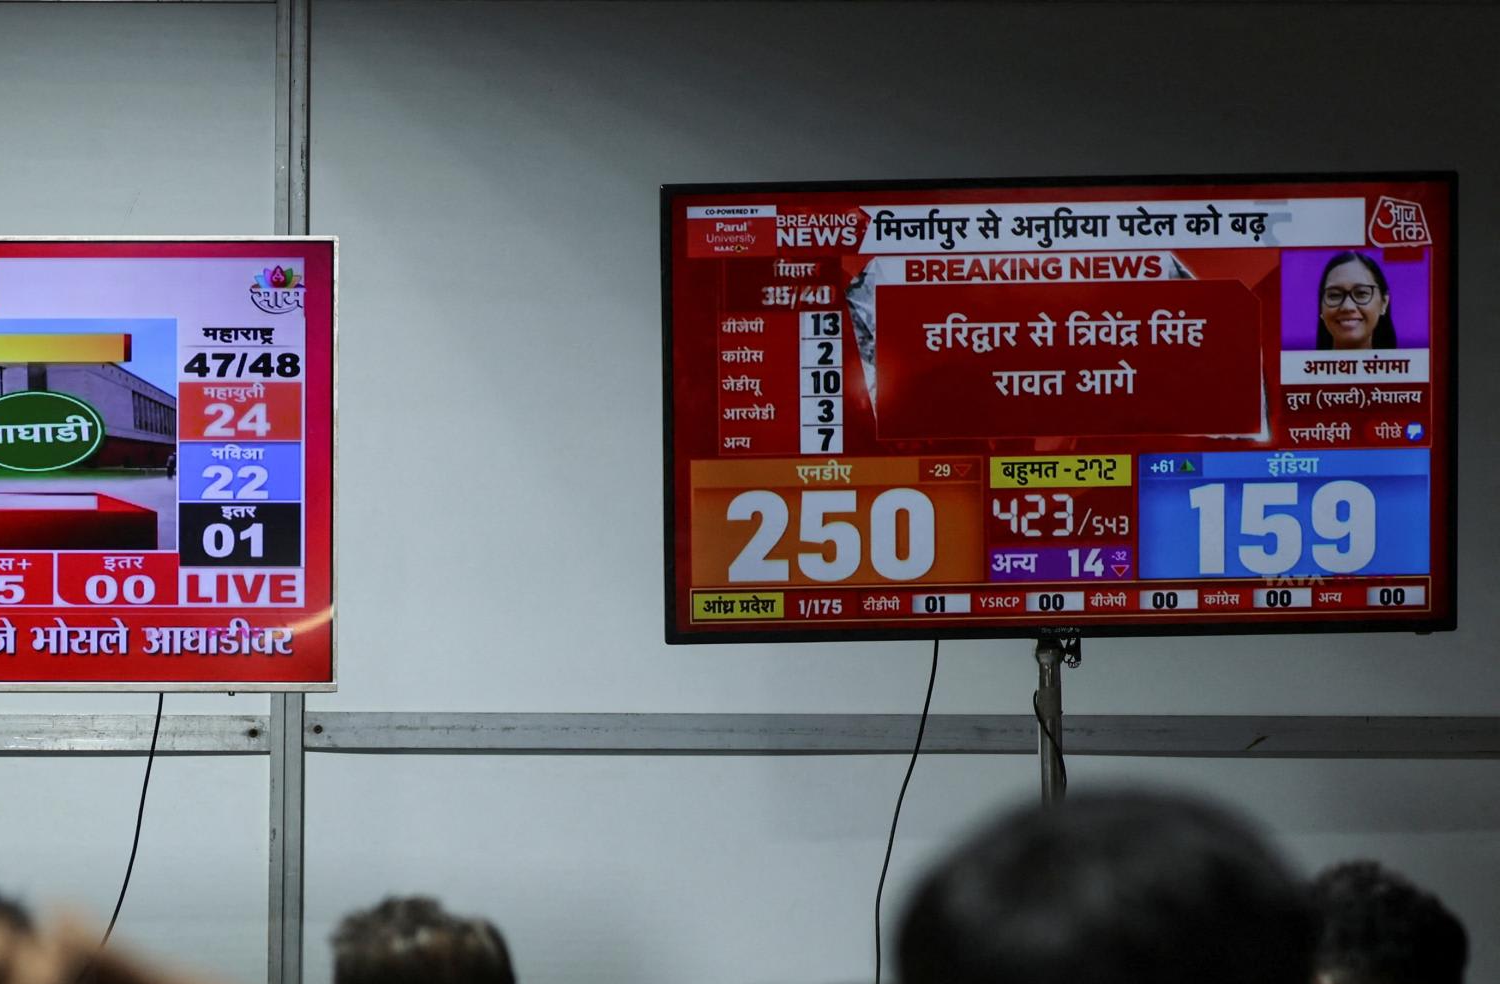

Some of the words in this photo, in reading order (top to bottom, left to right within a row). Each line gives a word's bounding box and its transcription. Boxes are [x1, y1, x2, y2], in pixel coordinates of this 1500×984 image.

[716, 222, 747, 232] Parul
[776, 213, 858, 227] BREAKING
[873, 209, 970, 249] मिर्जापुर
[977, 210, 1001, 239] से
[1011, 207, 1109, 247] अनुप्रिया
[1117, 207, 1177, 237] पटेल
[1184, 205, 1221, 236] को
[1229, 212, 1268, 242] बढ़
[706, 233, 757, 245] University
[776, 227, 858, 247] NEWS
[905, 257, 1063, 282] BREAKING
[1070, 256, 1162, 279] NEWS
[202, 328, 274, 344] महाराष्ट्र
[721, 317, 764, 333] बीजेपी
[811, 313, 840, 336] 13
[923, 313, 1019, 353] हरिद्वार
[1028, 312, 1057, 347] से
[1065, 311, 1141, 347] त्रिवेंद्र
[1148, 309, 1206, 347] सिंह
[184, 353, 300, 378] 47/48
[722, 347, 764, 363] कांग्रेस
[817, 342, 833, 365] 2
[1303, 360, 1358, 375] अगाथा
[1362, 355, 1410, 374] संगमा
[722, 375, 762, 396] जेडीयू
[811, 370, 840, 394] 10
[993, 370, 1066, 396] रावत
[1075, 360, 1136, 395] आगे
[203, 384, 265, 403] महायुती
[1286, 392, 1311, 411] तुरा
[203, 402, 271, 437] 24
[723, 404, 775, 420] आरजेडी
[817, 399, 834, 423] 3
[724, 437, 751, 448] अन्य
[817, 428, 834, 451] 7
[1375, 422, 1402, 439] पीछे
[211, 444, 264, 460] मविआ
[1150, 460, 1174, 473] +61
[1267, 452, 1319, 477] इंडिया
[201, 465, 269, 500] 22
[796, 459, 852, 484] एनडीए
[928, 463, 951, 477] -29
[1001, 460, 1059, 485] बहुमत
[221, 506, 256, 520] इतर
[727, 487, 935, 582] 250
[1189, 480, 1376, 575] 159
[203, 523, 263, 558] 01
[102, 556, 144, 571] इतर
[992, 553, 1038, 574] अन्य
[1068, 548, 1104, 577] 14
[85, 574, 156, 605] 00
[186, 574, 296, 603] LIVE
[703, 596, 735, 614] आंध्र
[739, 595, 776, 614] प्रदेश
[799, 599, 843, 618] 1/175
[863, 593, 900, 611] टीडीपी
[925, 595, 946, 612] 01
[979, 596, 1020, 608] YSRCP
[1038, 593, 1065, 612] 00
[1090, 592, 1127, 607] बीजेपी
[1152, 591, 1178, 609] 00
[1204, 589, 1239, 605] कांग्रेस
[1266, 589, 1292, 607] 00
[1318, 592, 1342, 603] अन्य
[1379, 588, 1405, 606] 00
[30, 618, 129, 655] भोसले
[143, 618, 294, 655] आघाडीवर
